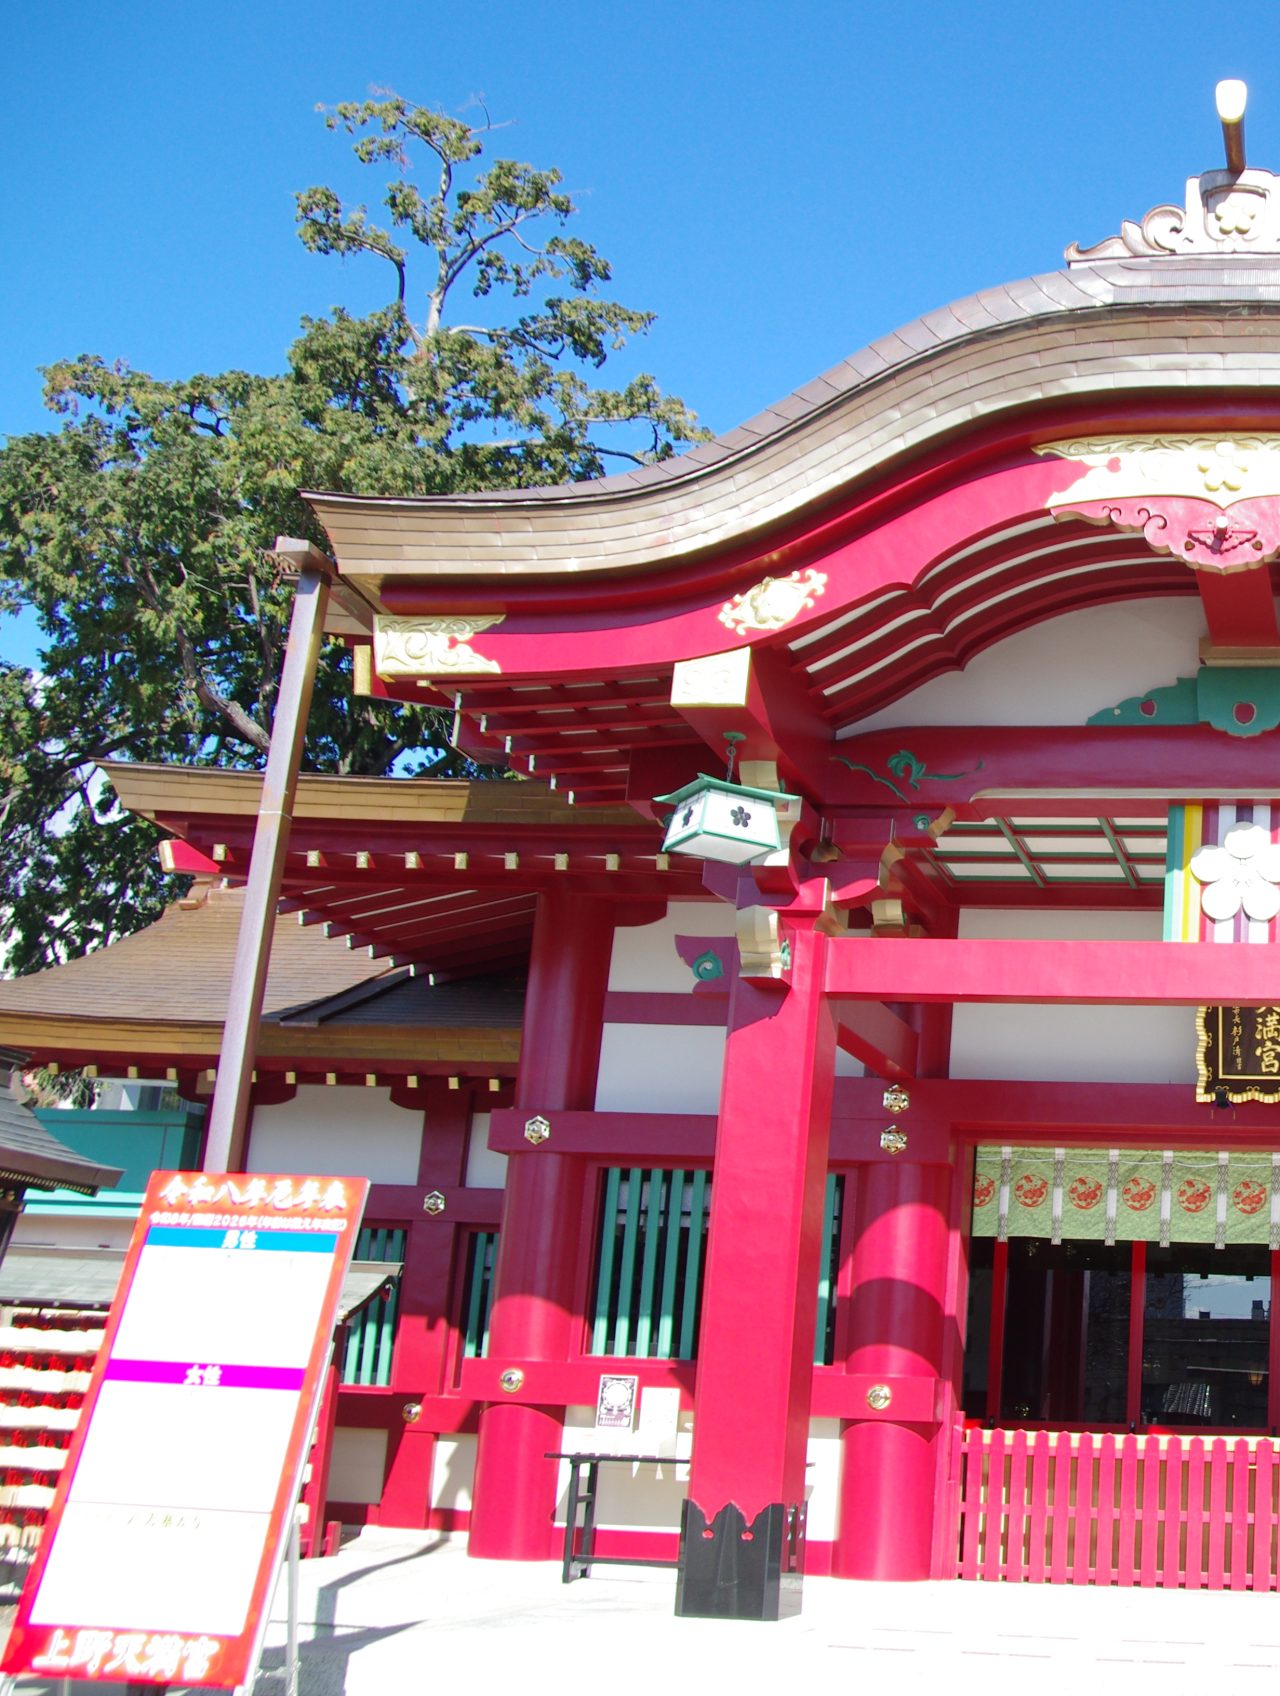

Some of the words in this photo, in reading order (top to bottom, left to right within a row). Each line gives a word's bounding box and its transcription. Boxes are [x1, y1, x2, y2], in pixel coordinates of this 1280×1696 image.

[222, 1230, 258, 1249] 男性
[183, 1363, 223, 1385] 女性
[32, 1628, 220, 1680] 上野天満宮
